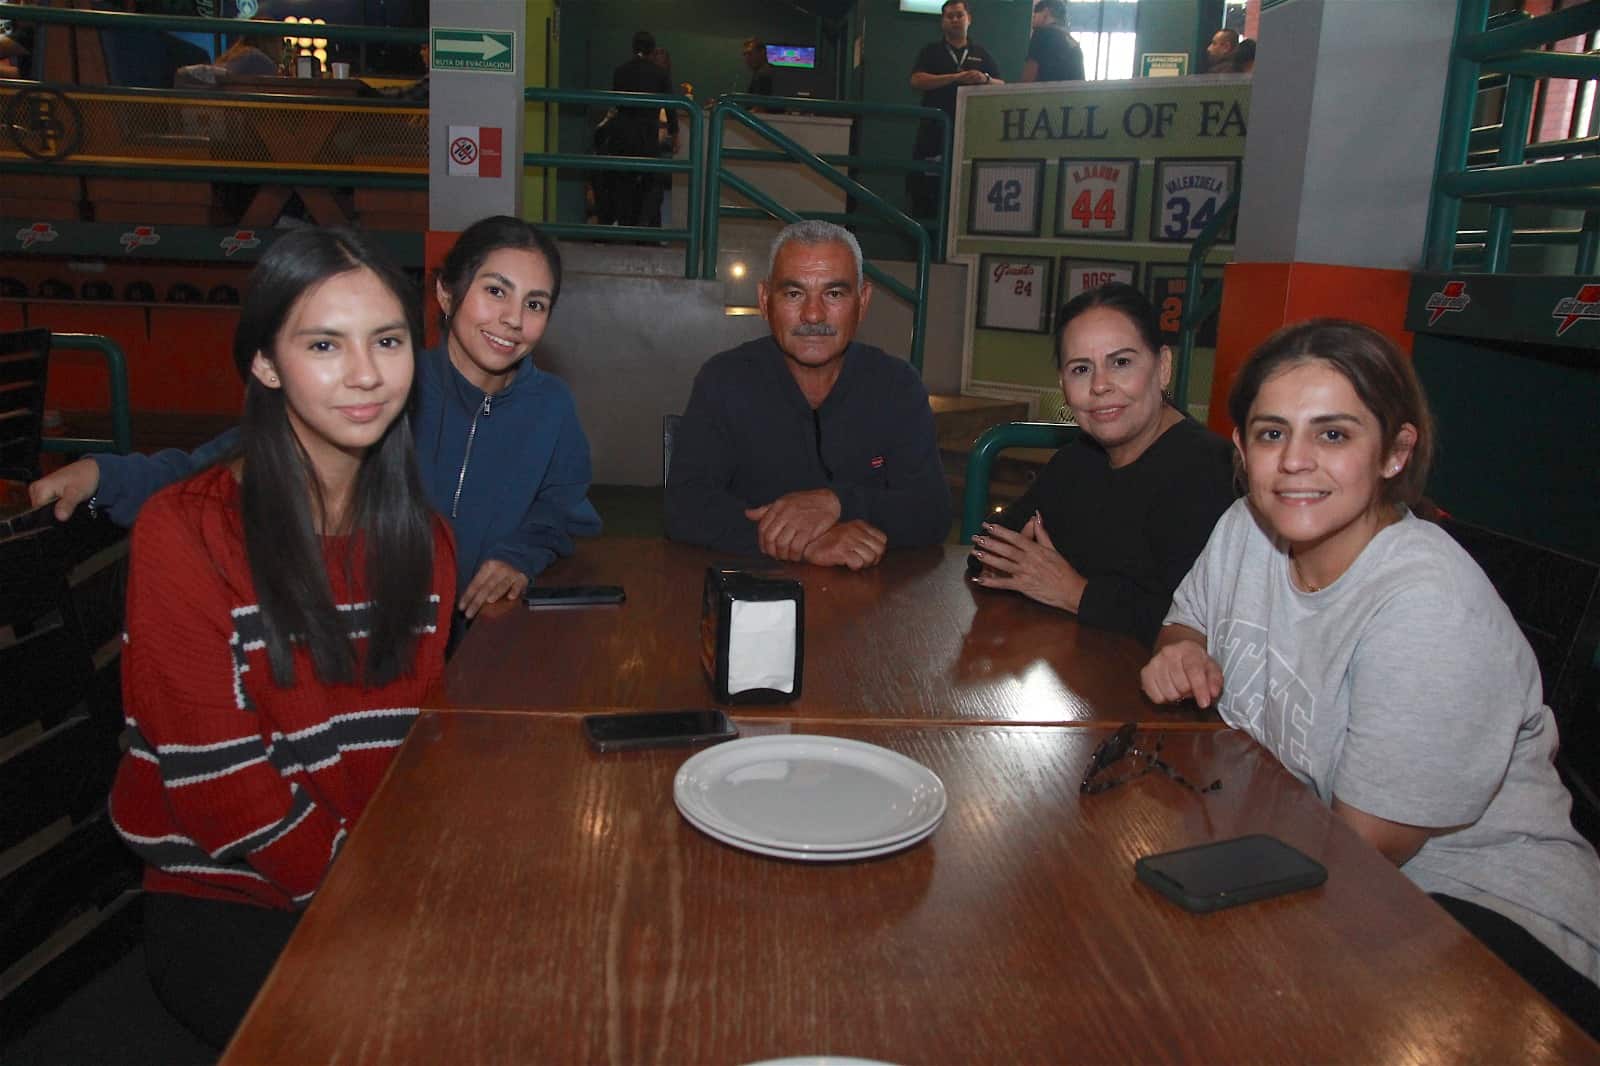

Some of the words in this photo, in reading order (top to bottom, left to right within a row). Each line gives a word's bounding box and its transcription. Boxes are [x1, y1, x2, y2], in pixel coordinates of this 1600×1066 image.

[999, 106, 1108, 142] HALL
[1122, 102, 1178, 138] OF
[987, 178, 1022, 213] 42
[1164, 174, 1224, 195] VALENZUELA
[1071, 187, 1117, 229] 44
[1013, 279, 1033, 297] 24
